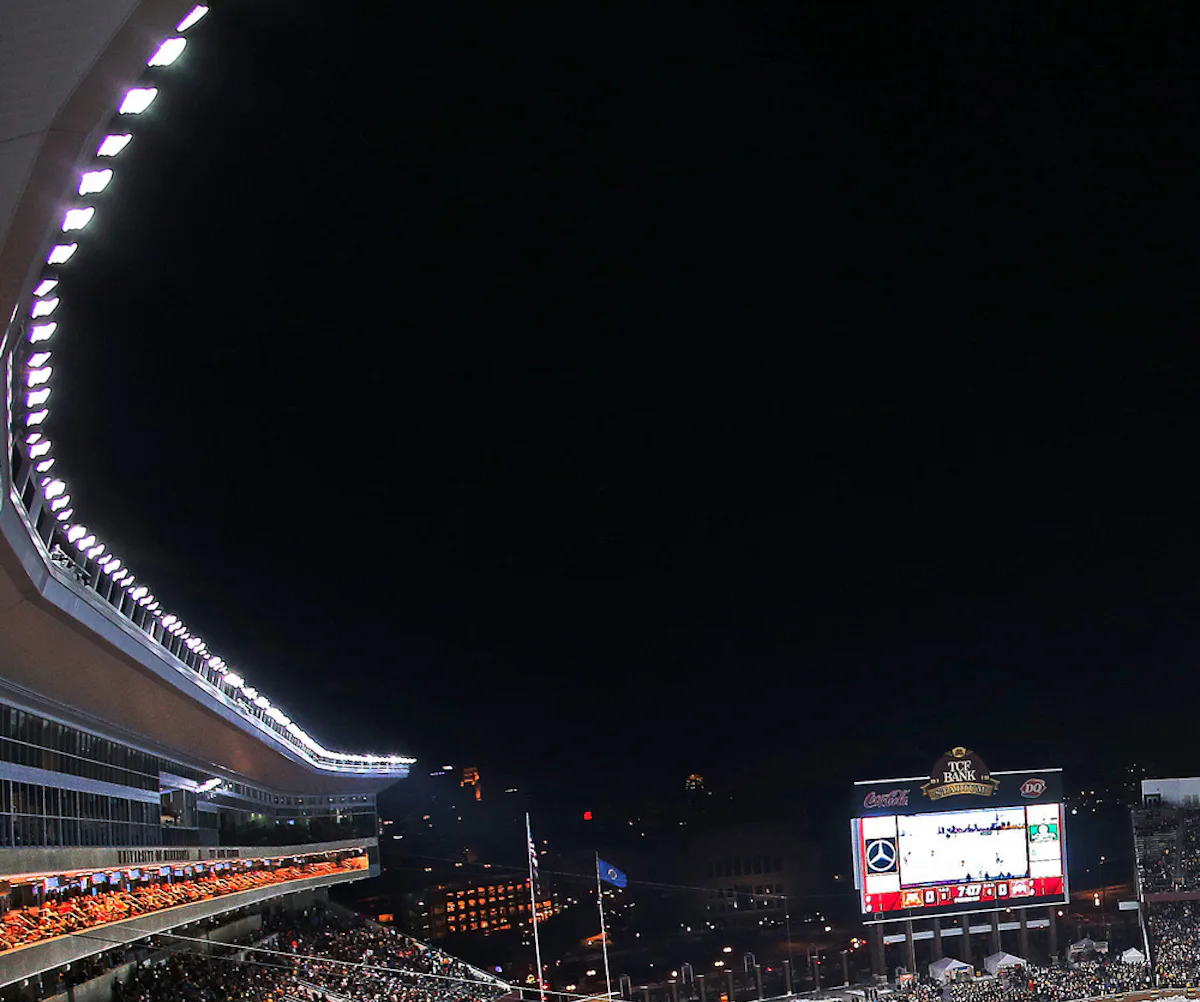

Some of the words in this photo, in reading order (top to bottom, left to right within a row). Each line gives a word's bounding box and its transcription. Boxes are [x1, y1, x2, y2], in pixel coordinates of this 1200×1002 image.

[948, 760, 972, 773] TCF
[943, 769, 977, 783] BANK
[935, 783, 986, 796] STADIUM
[1025, 782, 1041, 793] DQ
